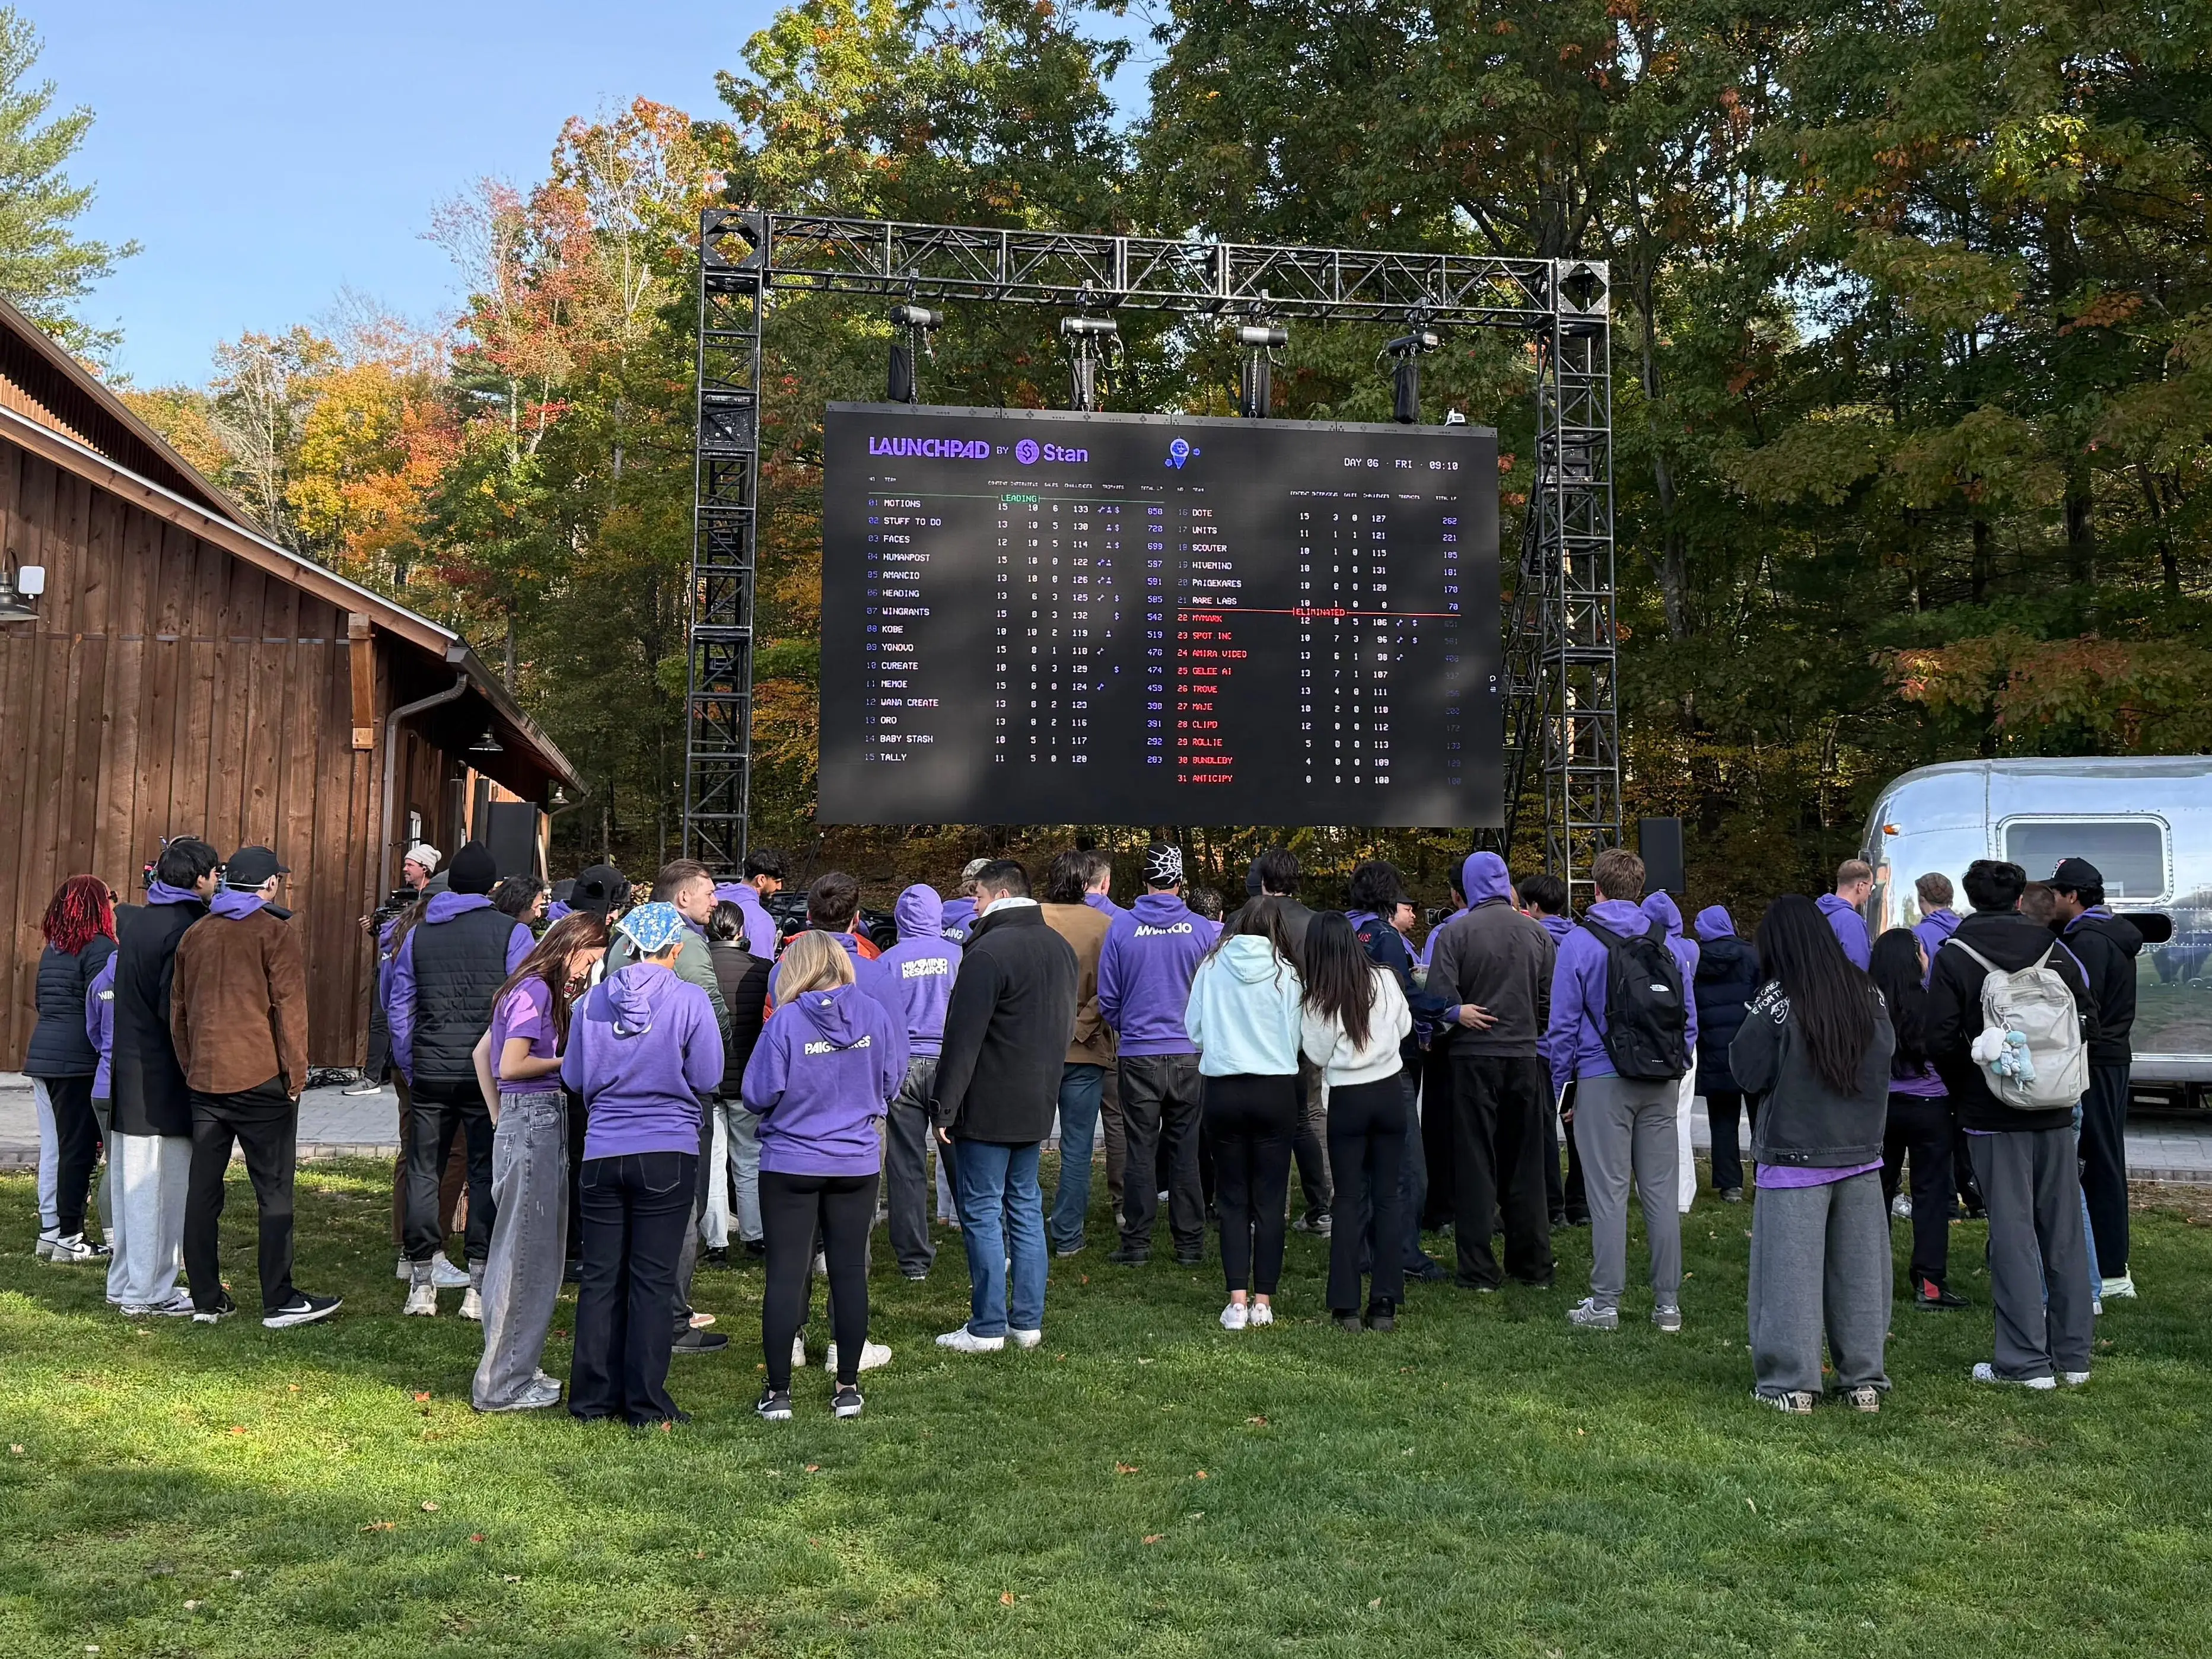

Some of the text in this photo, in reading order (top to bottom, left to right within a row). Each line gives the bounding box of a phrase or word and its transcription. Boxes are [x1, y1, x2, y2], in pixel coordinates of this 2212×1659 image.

[869, 437, 1089, 462] LAUNCHPAD BY Stan
[1344, 457, 1459, 470] DAY 06 FRI 09:10
[1001, 494, 1037, 502] LEADING
[884, 499, 921, 508] MOTIONS
[1052, 504, 1059, 512] 6
[1073, 505, 1089, 513] 133
[1192, 508, 1458, 525] DOTE 15 3 127 262
[883, 517, 1059, 530] STUFF TO DO 13 5
[1192, 526, 1457, 542] UNITS 11 121 221
[883, 534, 911, 543] FACES
[998, 538, 1008, 546] 12
[1052, 539, 1058, 547] 5
[1192, 543, 1227, 552] SCOUTER
[883, 553, 931, 562] HUMANPOST
[998, 556, 1008, 564] 15
[1373, 566, 1386, 575] 131
[883, 571, 920, 580] AMANCIO
[997, 574, 1007, 582] 13
[1072, 575, 1089, 584] 126
[882, 589, 920, 598] HEADING
[997, 591, 1007, 600] 13
[1052, 593, 1058, 601] 3
[1072, 593, 1089, 601] 125
[1192, 596, 1213, 604] RARE
[1217, 597, 1237, 605] LABS
[882, 607, 1163, 622] WINGRANTS 15 3 132 542
[1296, 608, 1345, 616] ELIMINATED
[1177, 613, 1189, 622] 22
[1301, 616, 1310, 625] 12
[1352, 617, 1359, 626] 5
[881, 625, 904, 633] KOBE
[1052, 628, 1058, 636] 2
[1072, 629, 1088, 637] 119
[1177, 631, 1188, 639] 23
[1334, 634, 1340, 642] 7
[1377, 635, 1387, 644] 96
[997, 645, 1007, 654] 15
[1177, 648, 1188, 658] 24
[1300, 651, 1310, 660] 13
[1333, 652, 1340, 660] 6
[881, 661, 919, 670] CUREATE
[1031, 664, 1037, 672] 6
[1052, 664, 1058, 673] 3
[1072, 665, 1088, 673] 129
[1177, 667, 1188, 676] 25
[1301, 669, 1310, 677] 13
[881, 680, 908, 688] MEMOE
[996, 682, 1007, 690] 15
[1072, 683, 1087, 691] 124
[1193, 685, 1218, 693] TROVE
[1301, 686, 1311, 695] 13
[1374, 688, 1387, 696] 111
[880, 698, 1087, 709] WANA CREATE 13 2 123
[1334, 705, 1341, 713] 2
[880, 716, 897, 724] ORO
[1051, 718, 1057, 727] 2
[1072, 718, 1087, 727] 116
[1301, 722, 1312, 730] 12
[1374, 723, 1389, 731] 112
[880, 734, 902, 743] BABY
[906, 734, 934, 743] STASH
[1030, 735, 1036, 744] 5
[1072, 736, 1087, 745] 117
[1177, 737, 1389, 749] 29 ROLLIE 5 113
[880, 753, 1036, 762] TALLY 11 5
[1177, 774, 1233, 784] 31 ANTICIPY
[901, 958, 948, 970] HIVEMIND
[902, 966, 948, 979] RESEARCH
[1758, 995, 1775, 1010] FOR
[804, 1035, 871, 1055] PAIGES
